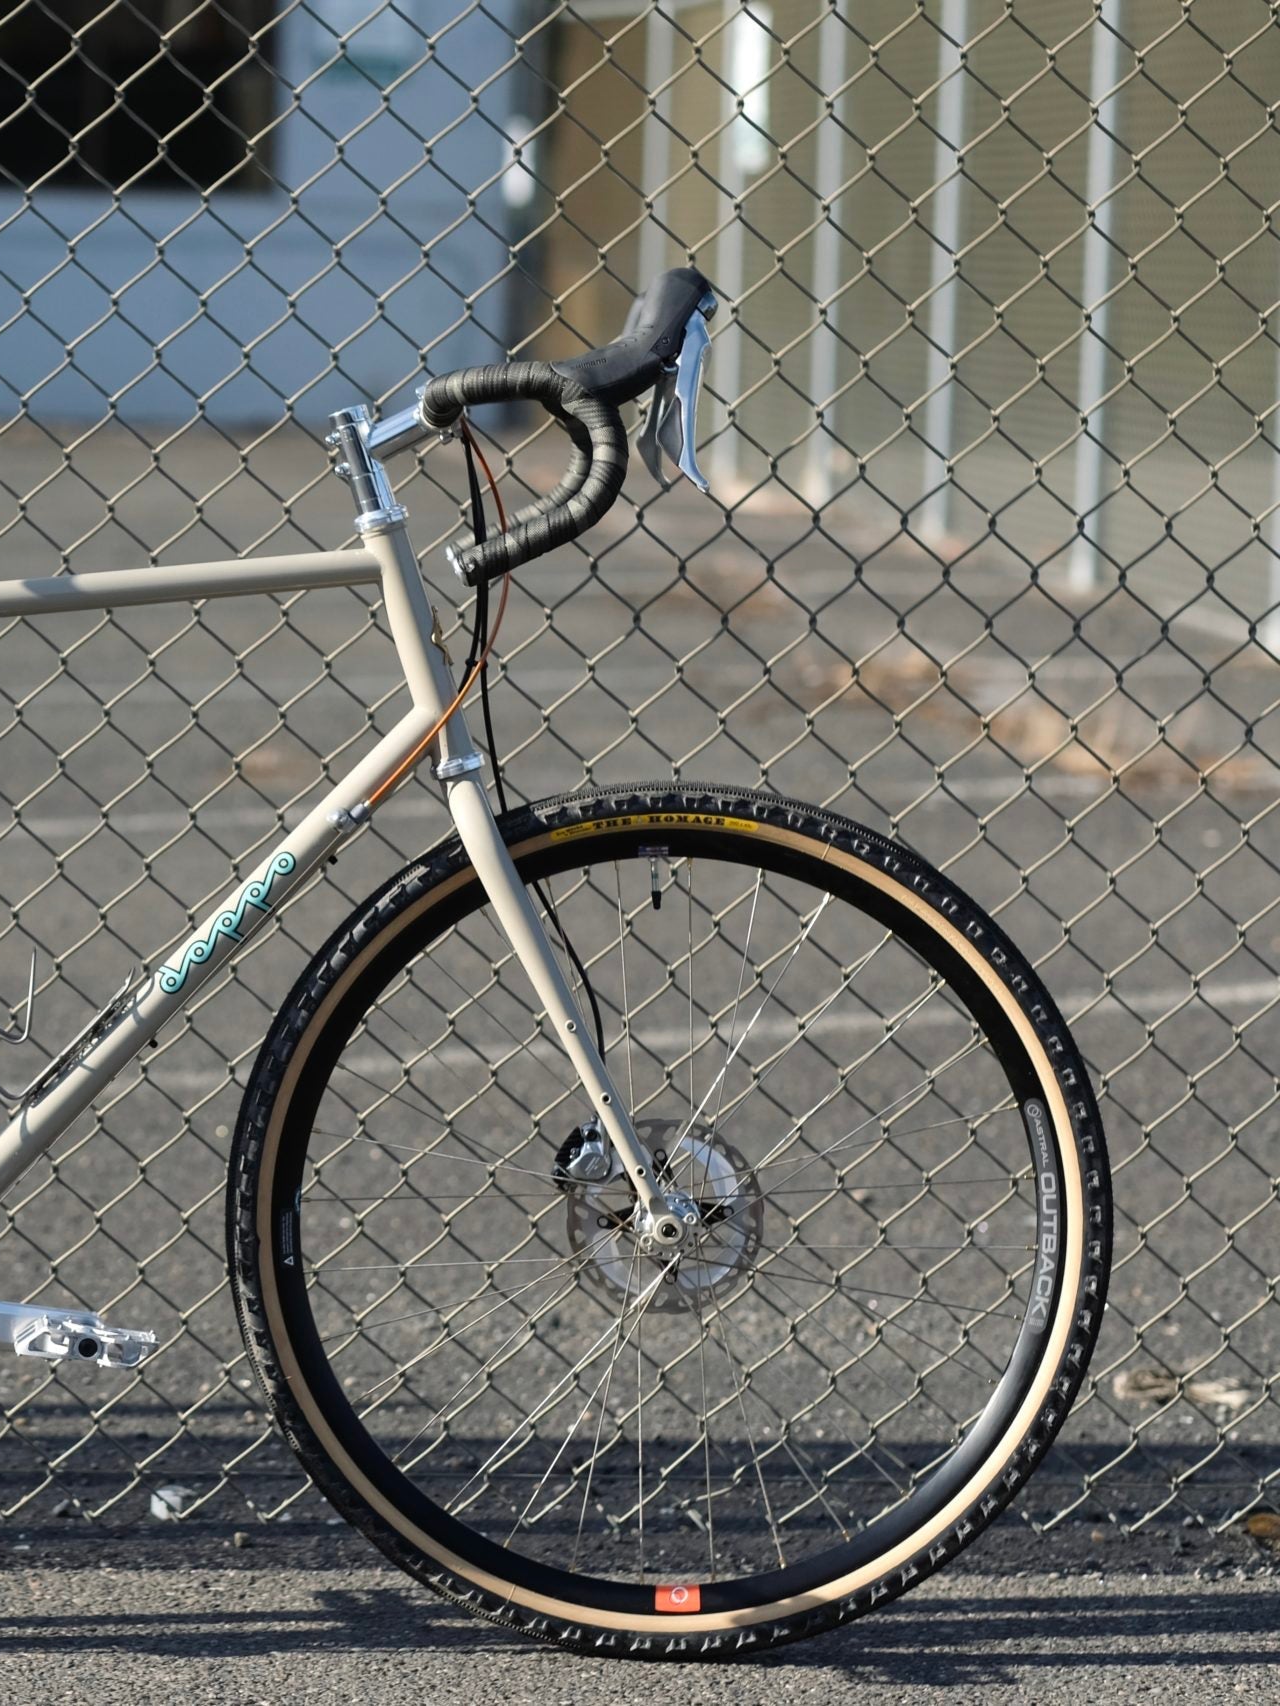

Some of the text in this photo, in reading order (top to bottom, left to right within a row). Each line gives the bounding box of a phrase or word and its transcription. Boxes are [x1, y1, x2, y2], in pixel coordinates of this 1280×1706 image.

[593, 817, 632, 830] THE
[648, 814, 725, 826] HOMAGE
[158, 851, 296, 994] doppo
[1033, 1118, 1049, 1168] ASTRAL
[1030, 1171, 1058, 1319] OUTBACK
